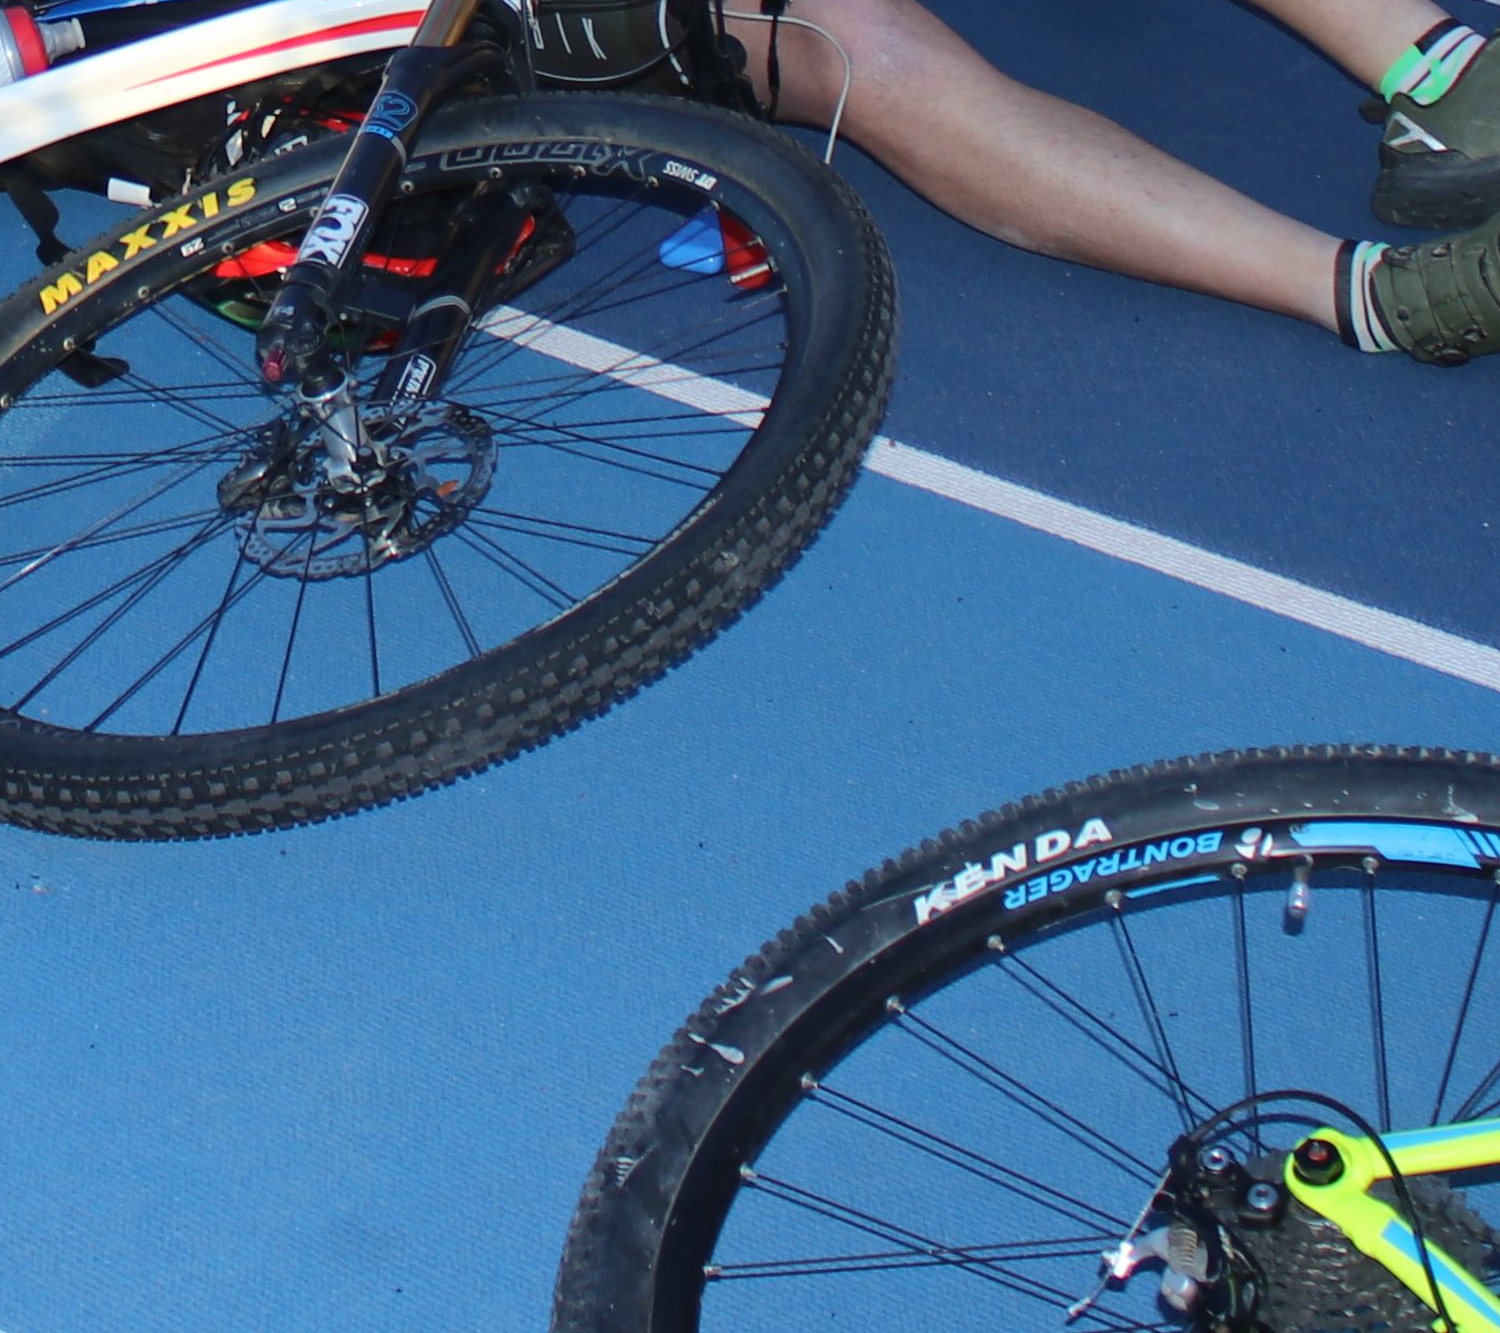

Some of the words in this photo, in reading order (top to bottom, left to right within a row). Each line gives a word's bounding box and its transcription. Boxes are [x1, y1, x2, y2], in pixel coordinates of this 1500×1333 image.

[38, 174, 259, 317] MAXXIS
[296, 193, 371, 272] FOX
[914, 817, 1112, 928] KENDA
[1004, 829, 1222, 910] BONTRAGER
